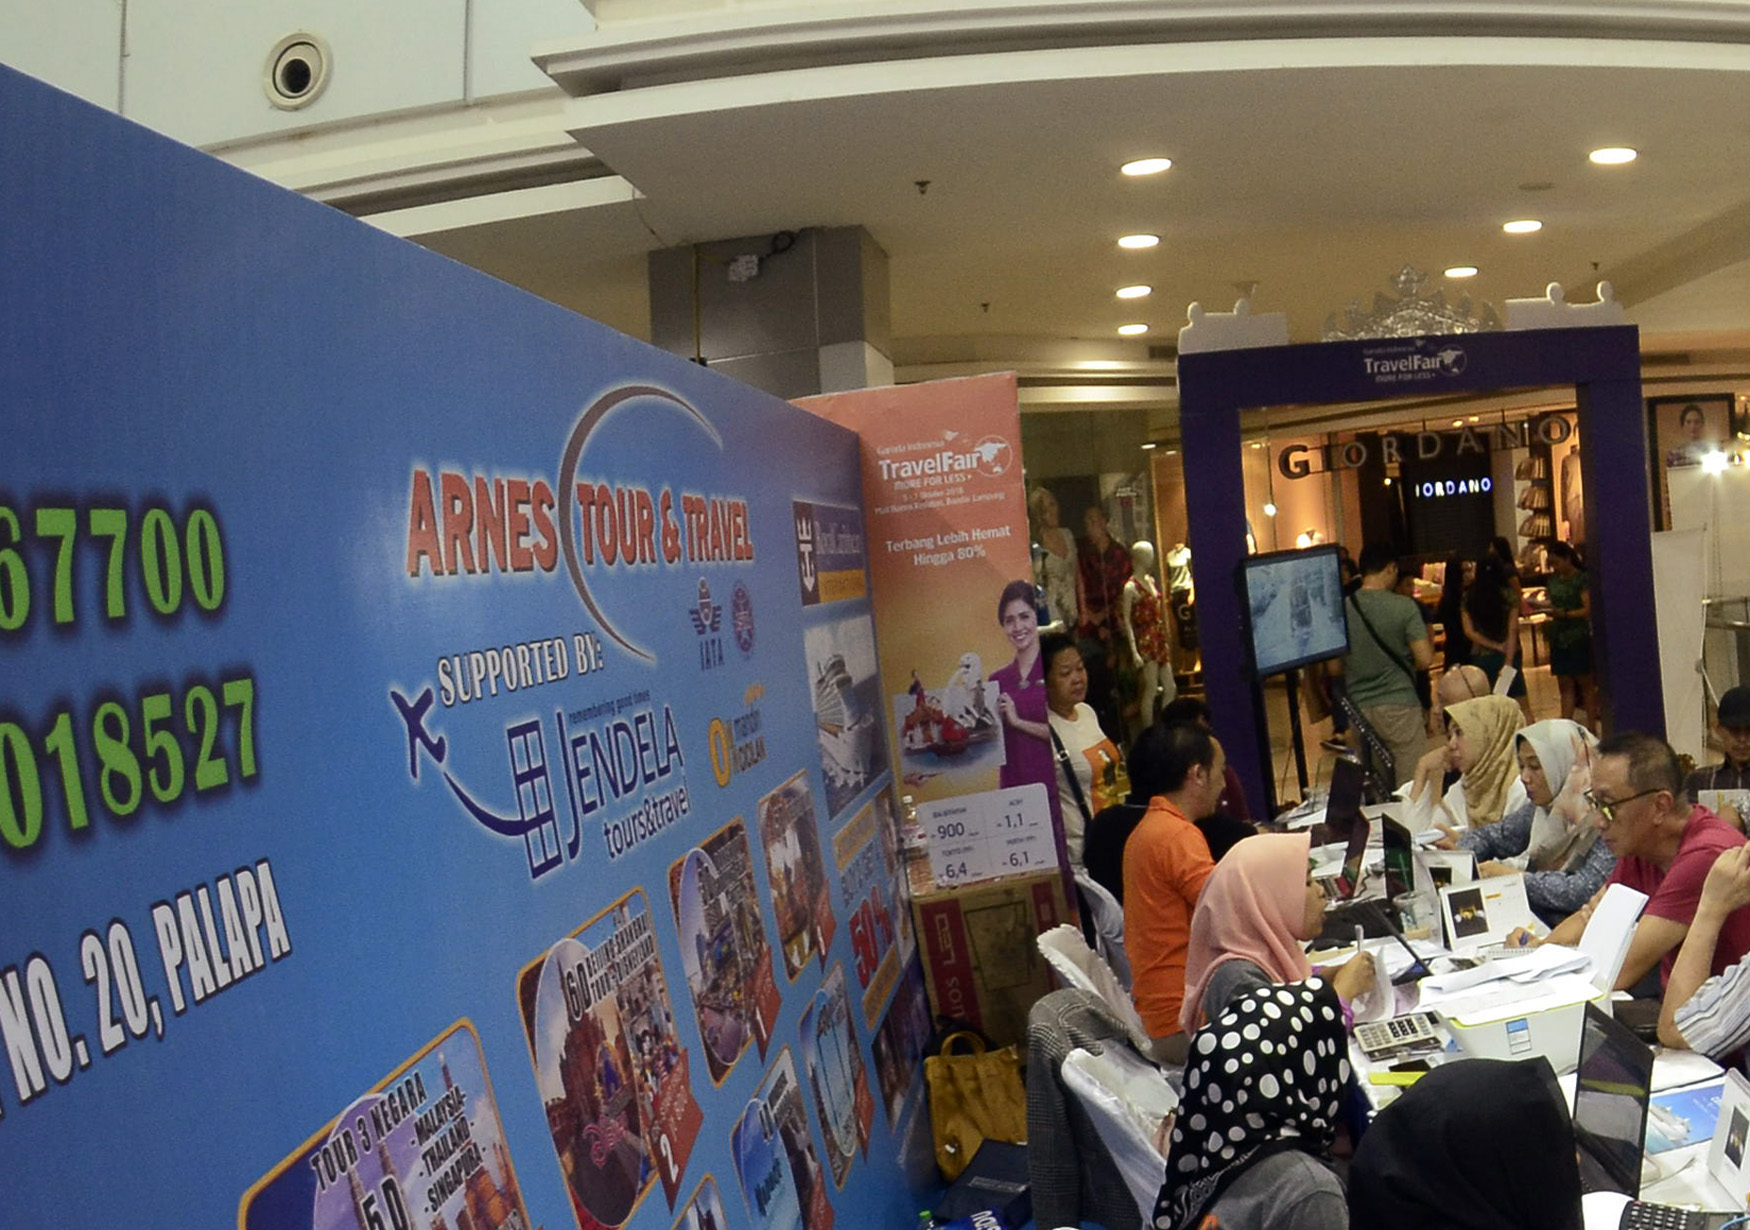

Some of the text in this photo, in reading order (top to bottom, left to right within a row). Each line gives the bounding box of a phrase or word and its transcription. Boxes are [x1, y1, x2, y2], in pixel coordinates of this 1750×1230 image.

[1364, 354, 1442, 374] TravelFair
[878, 451, 982, 481] TravelFair
[1279, 415, 1571, 480] GIORDANO
[1415, 476, 1492, 498] IORDANO
[406, 470, 559, 577] ARNES
[576, 483, 657, 566] TOUR
[660, 487, 682, 563] &
[682, 494, 754, 562] TRAVEL
[885, 525, 1012, 553] Terbang Lebih Hemat
[0, 508, 225, 630] 67700
[913, 544, 987, 566] Hingga 80%
[438, 631, 604, 707] SUPPORTED BY:
[0, 678, 257, 848] 018527
[556, 705, 684, 861] JENDELA
[937, 821, 965, 840] 900
[1004, 813, 1025, 829] 1,1
[945, 862, 968, 879] 6,4
[1009, 851, 1030, 868] 6,1
[0, 861, 291, 1101] NO. 20, PALAPA
[310, 1070, 428, 1192] TOUR 3 NEGARA
[660, 1133, 679, 1184] 2
